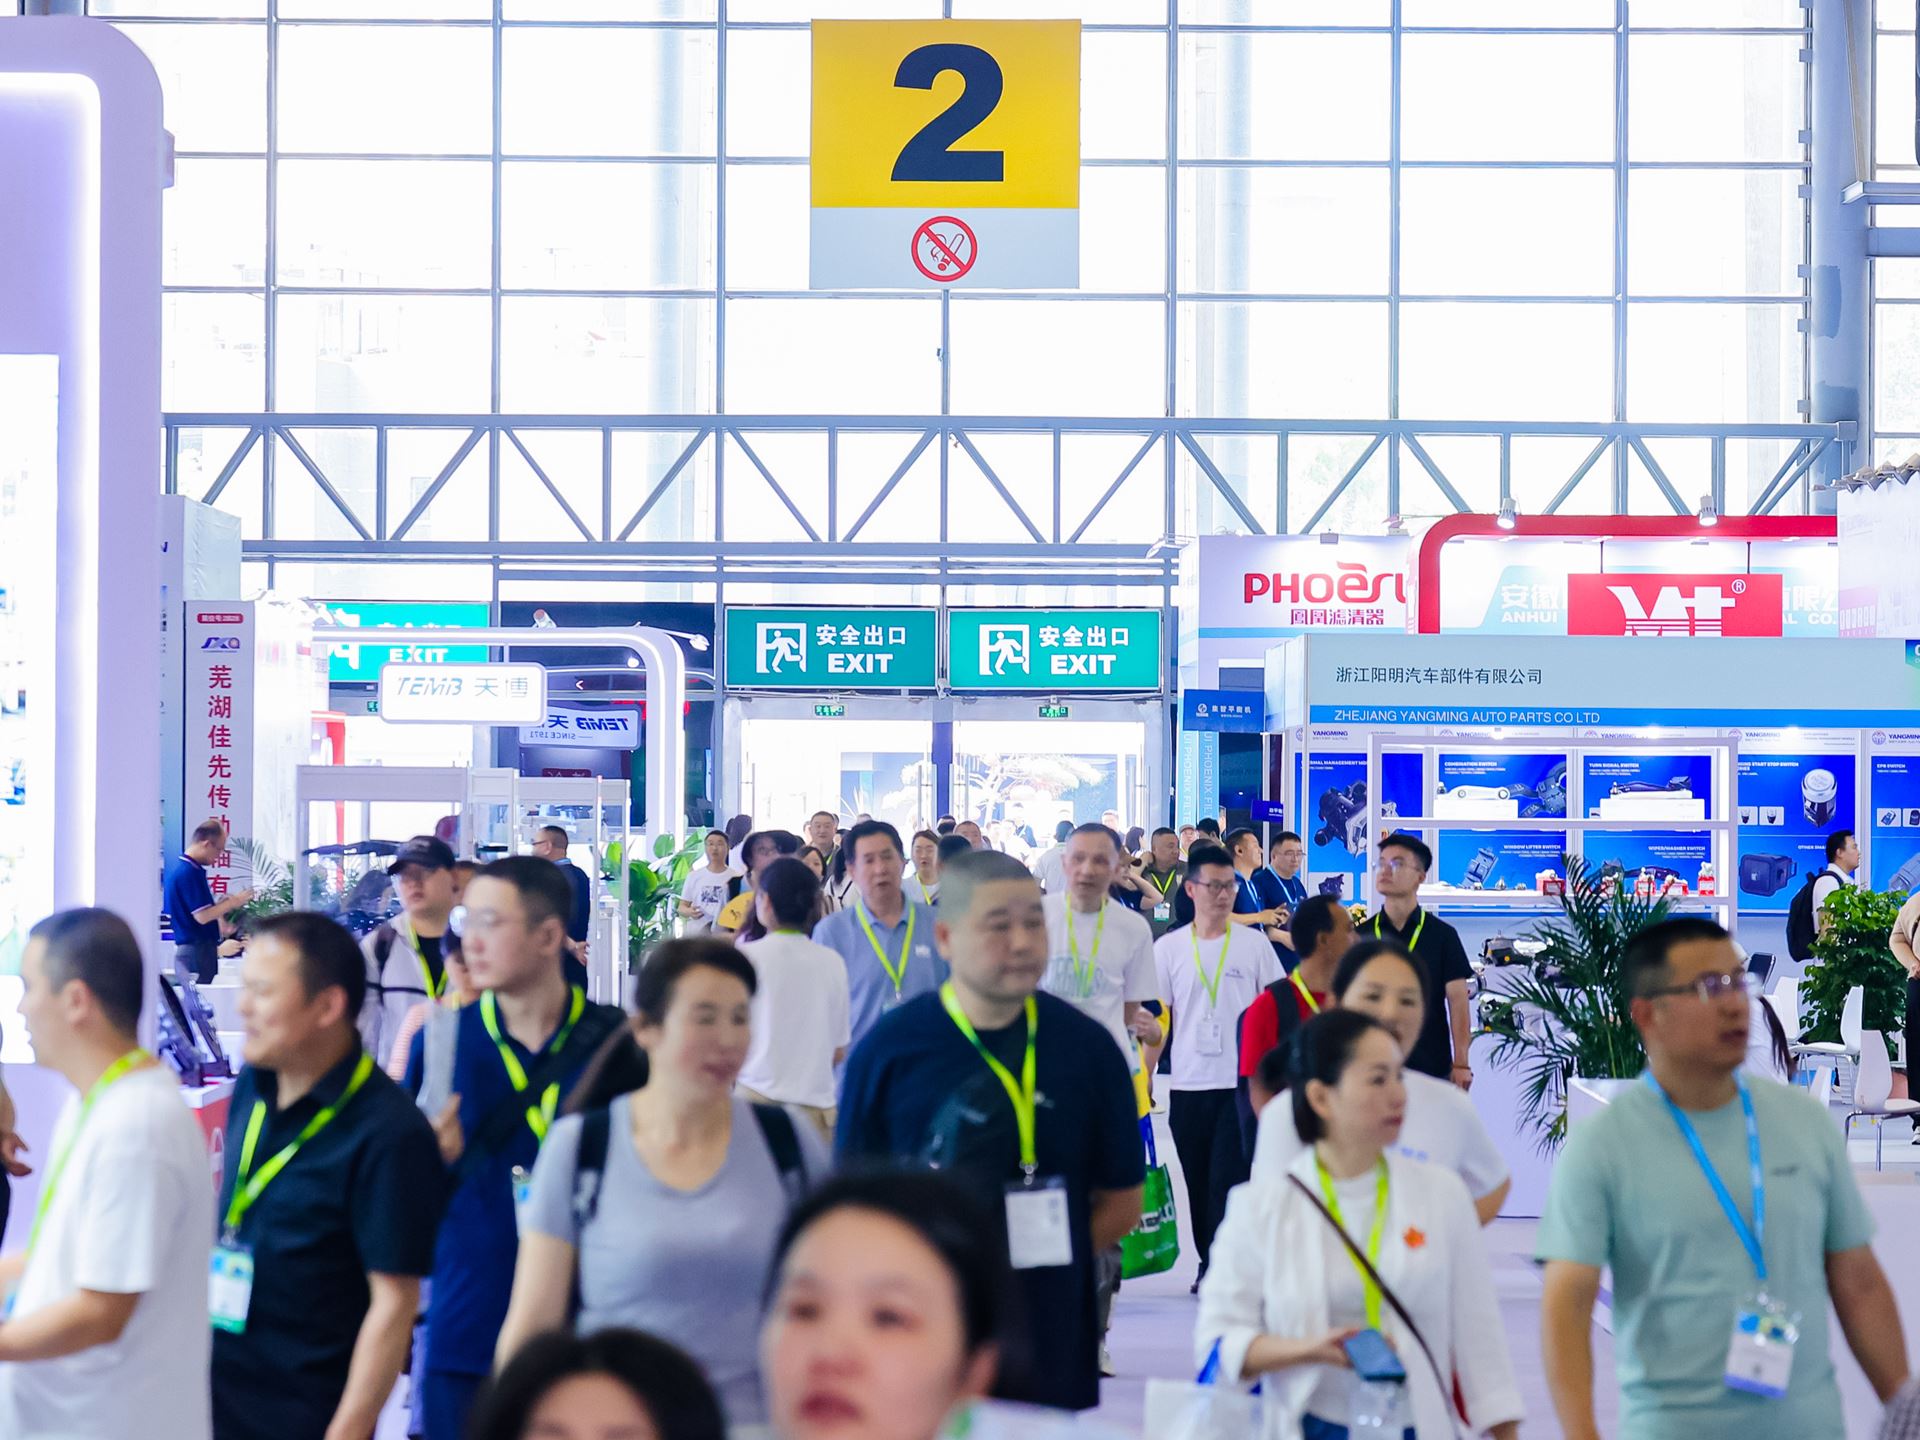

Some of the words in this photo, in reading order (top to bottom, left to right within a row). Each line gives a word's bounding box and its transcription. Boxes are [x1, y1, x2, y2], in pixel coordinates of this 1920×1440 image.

[890, 43, 1004, 182] 2
[1501, 610, 1558, 623] ANHUI
[816, 624, 906, 647] 安全出口
[1039, 625, 1129, 648] 安全出口
[389, 648, 449, 663] EXIT
[827, 653, 893, 673] EXIT
[1050, 654, 1117, 675] EXIT
[1336, 667, 1543, 685] 浙江阳明汽车部件有限公司
[1334, 709, 1397, 722] ZHEJIANG
[1399, 710, 1469, 723] YANGMING
[1471, 711, 1507, 723] AUTO
[1509, 711, 1551, 724] PARTS
[1553, 712, 1574, 724] CO
[1576, 712, 1600, 725] LTD
[1204, 745, 1213, 794] PHOENIX
